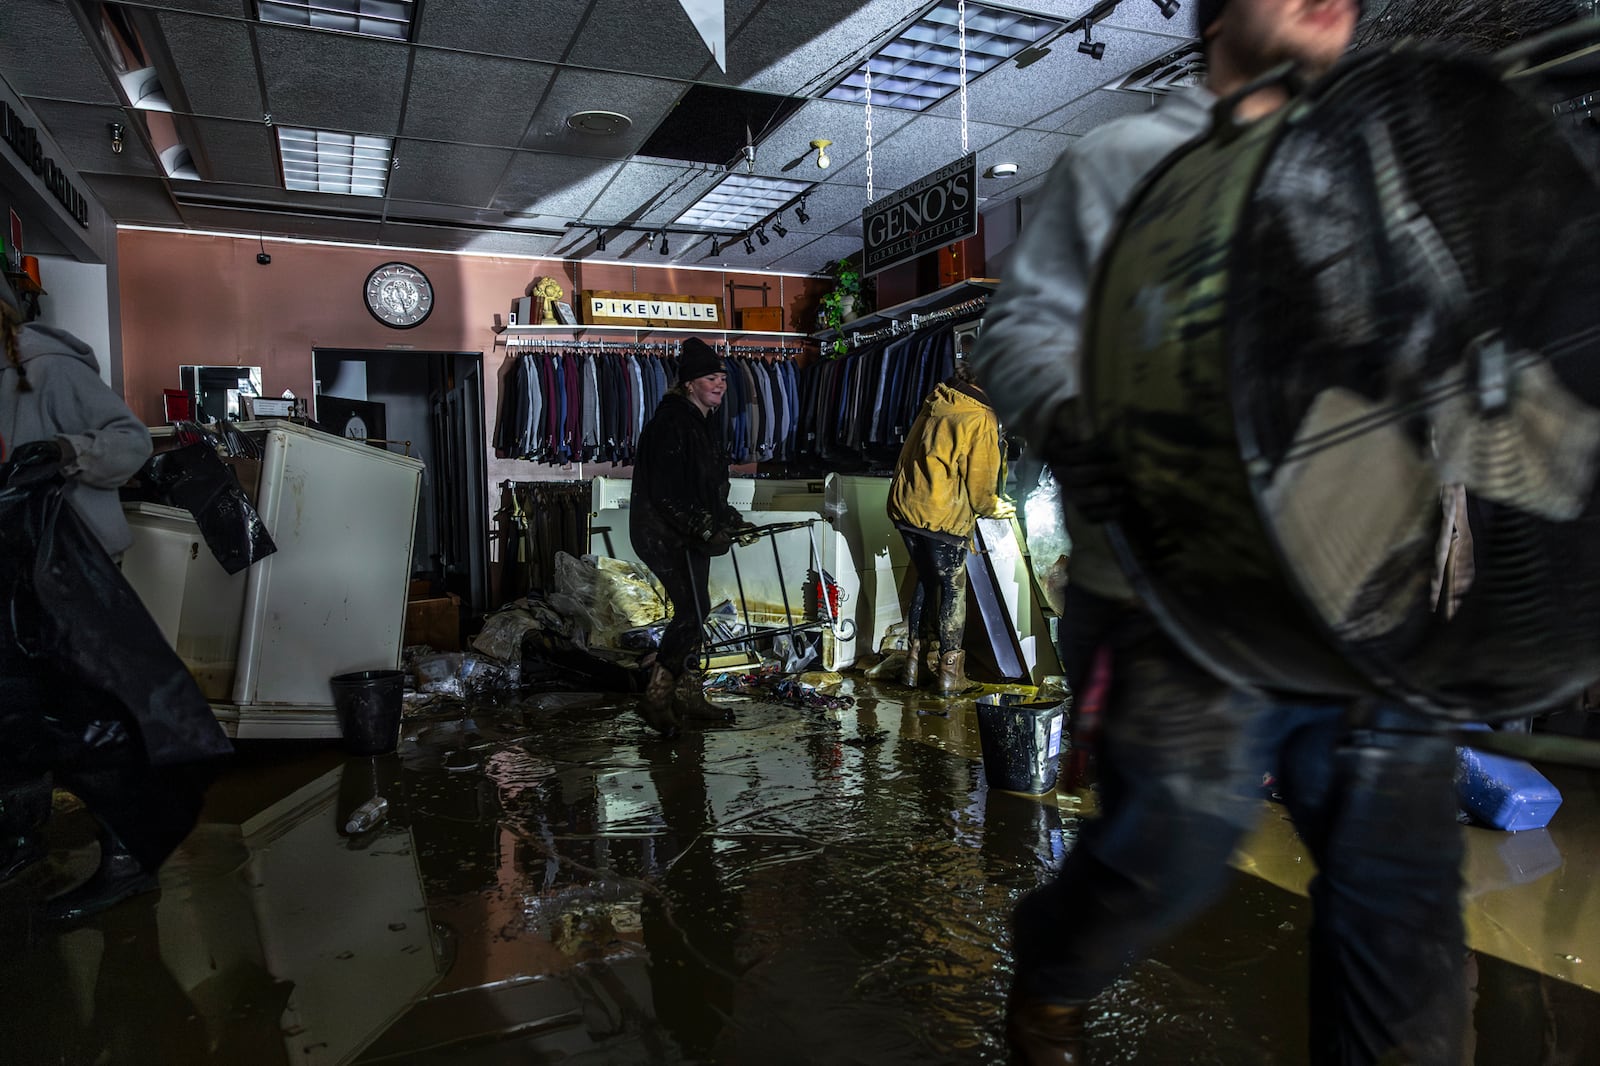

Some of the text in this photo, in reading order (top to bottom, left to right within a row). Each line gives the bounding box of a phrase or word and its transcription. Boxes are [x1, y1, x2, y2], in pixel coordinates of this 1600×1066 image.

[864, 156, 973, 217] TUXEDO RENTAL CENTER
[868, 172, 969, 248] GENO'S
[869, 217, 964, 263] FORMAL AFFAIR
[595, 302, 714, 317] PIKEVILLE
